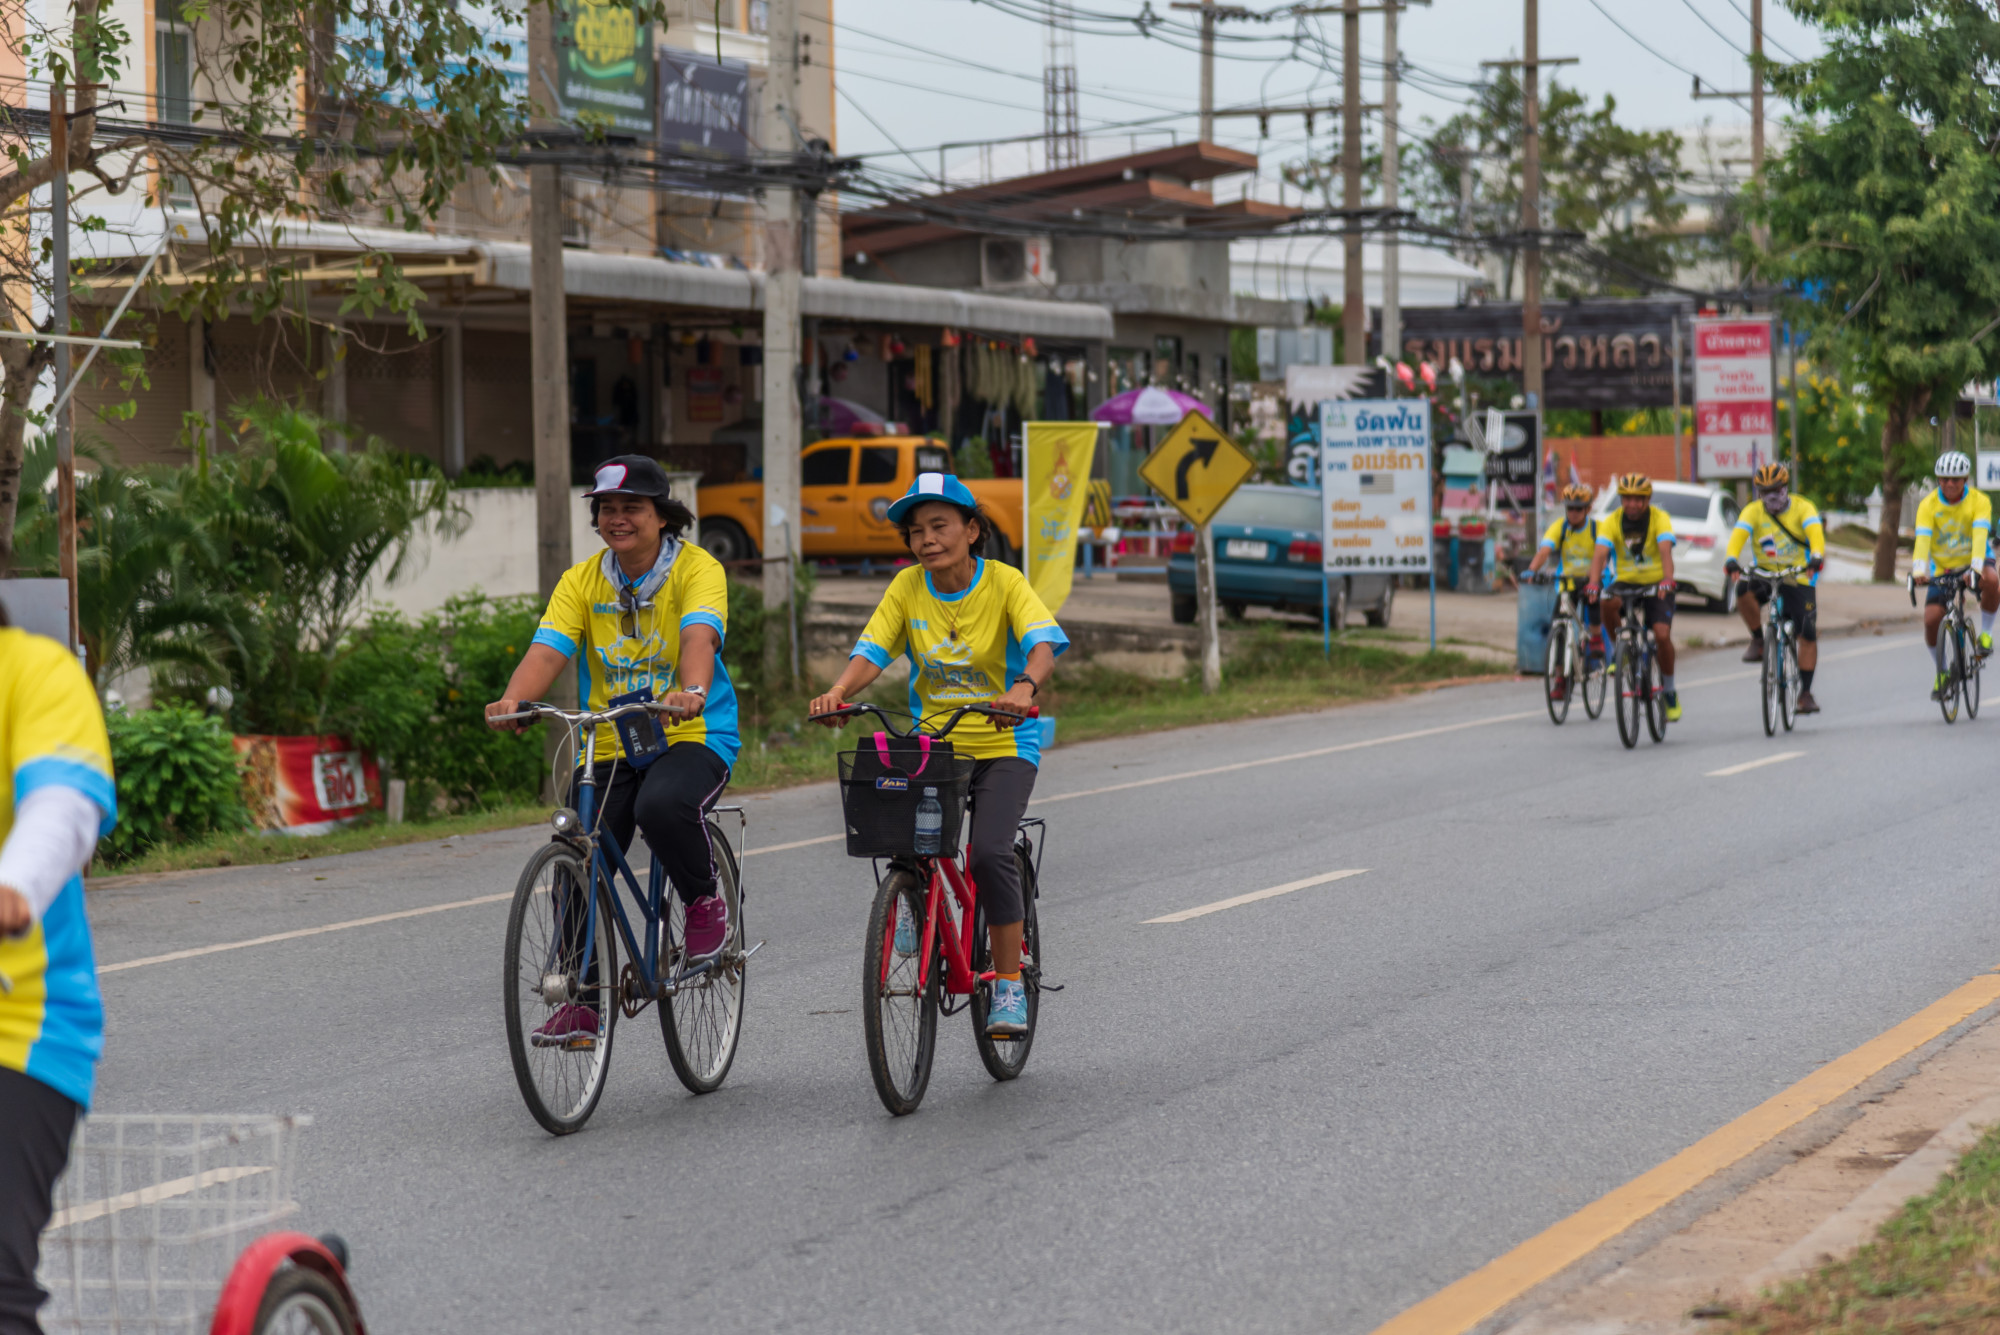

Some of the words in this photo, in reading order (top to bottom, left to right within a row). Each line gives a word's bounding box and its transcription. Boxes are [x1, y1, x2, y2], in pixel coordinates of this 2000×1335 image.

[1355, 405, 1422, 431] จัดฟัน
[1705, 411, 1731, 431] 24
[1352, 448, 1424, 471] อเมริกา
